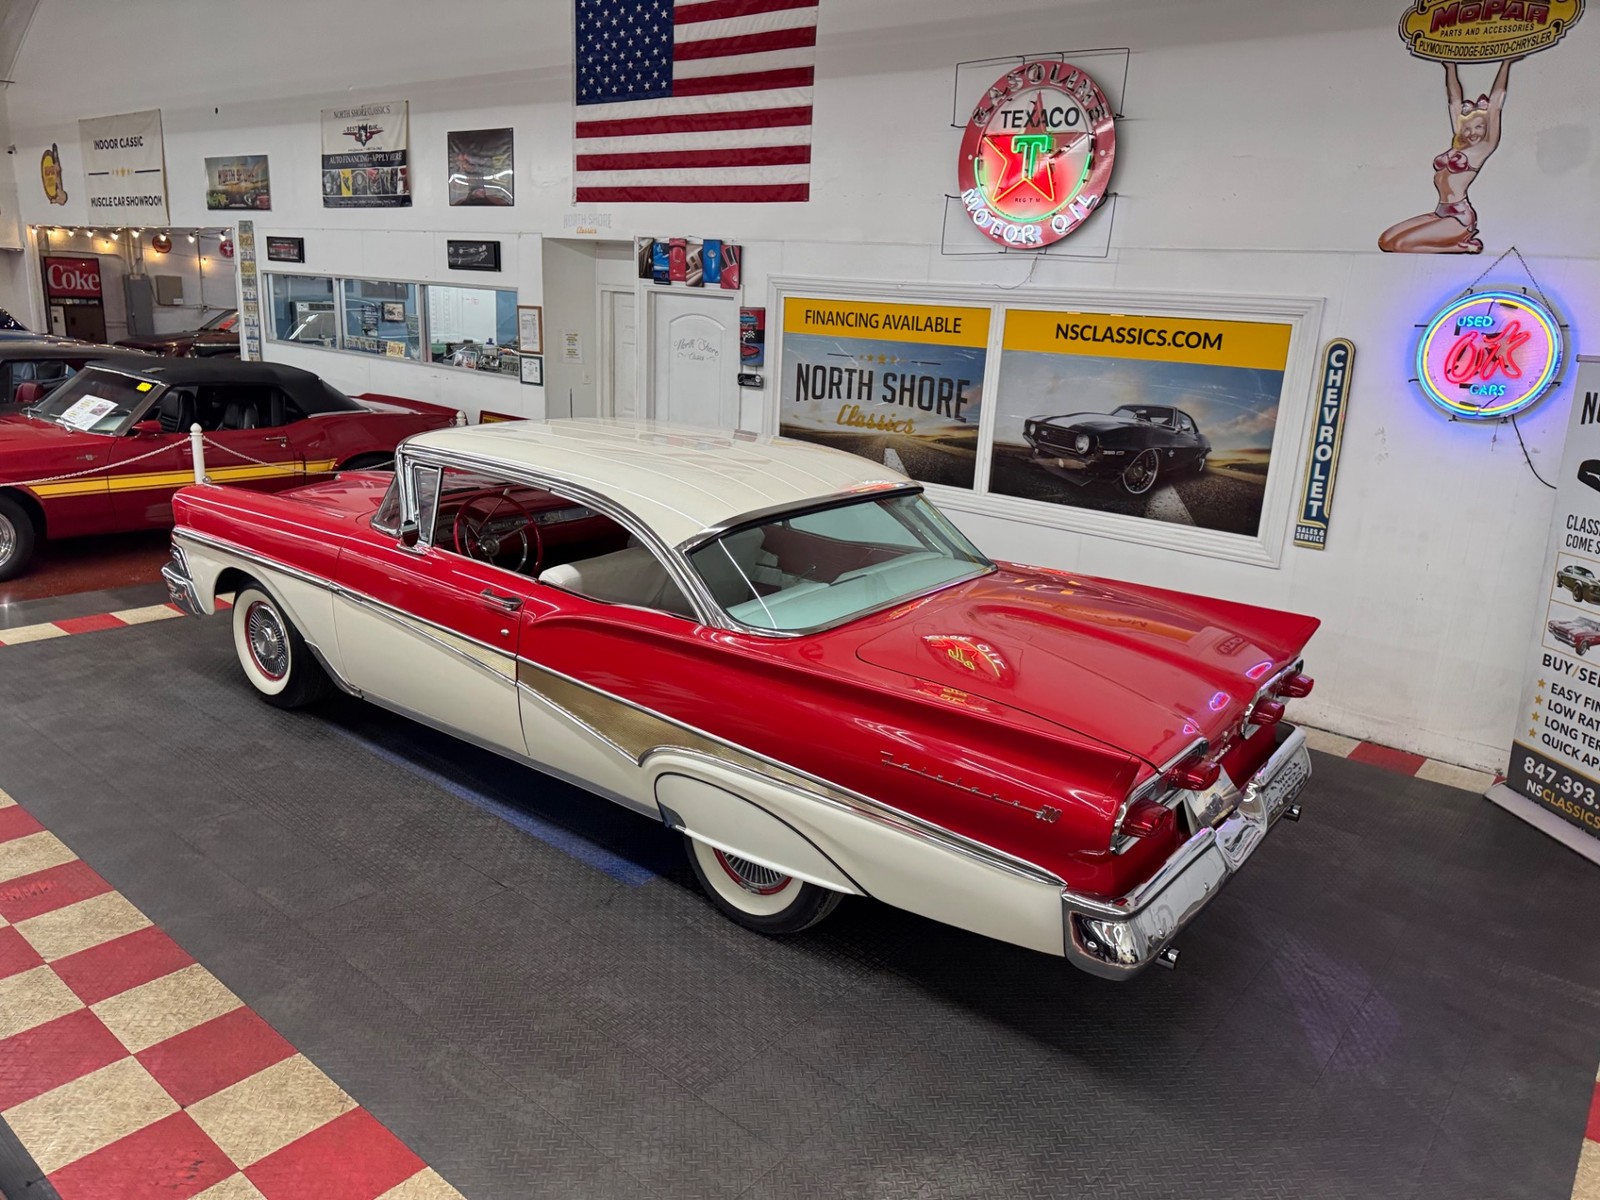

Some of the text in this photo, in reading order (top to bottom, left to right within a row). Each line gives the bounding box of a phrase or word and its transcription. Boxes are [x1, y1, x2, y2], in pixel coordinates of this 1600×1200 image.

[1440, 23, 1535, 38] PARTS AND ACCESSORIES
[1000, 106, 1080, 129] TEXACO
[93, 136, 144, 151] INDOOR CLASSIC
[91, 195, 163, 208] MUSCLE CAR SHOWROOM
[961, 188, 1098, 245] MOTOR OIL
[47, 263, 100, 291] Coke
[804, 309, 962, 334] FINANCING AVAILABLE
[1456, 315, 1494, 327] USED
[1055, 322, 1224, 351] NSCLASSICS.COM
[795, 362, 970, 424] NORTH SHORE
[1469, 384, 1507, 396] CARS
[836, 403, 916, 435] Classics
[1580, 391, 1600, 425] N
[1308, 349, 1346, 518] CHEVROLET
[1297, 526, 1325, 537] SALES &
[1566, 514, 1600, 537] CLASS
[1295, 532, 1325, 543] SERVICE
[1566, 533, 1594, 553] COME
[1550, 682, 1582, 704] EASY
[1547, 698, 1576, 720] LOW
[1544, 715, 1579, 741] LONG
[1541, 733, 1600, 771] QUICK AP
